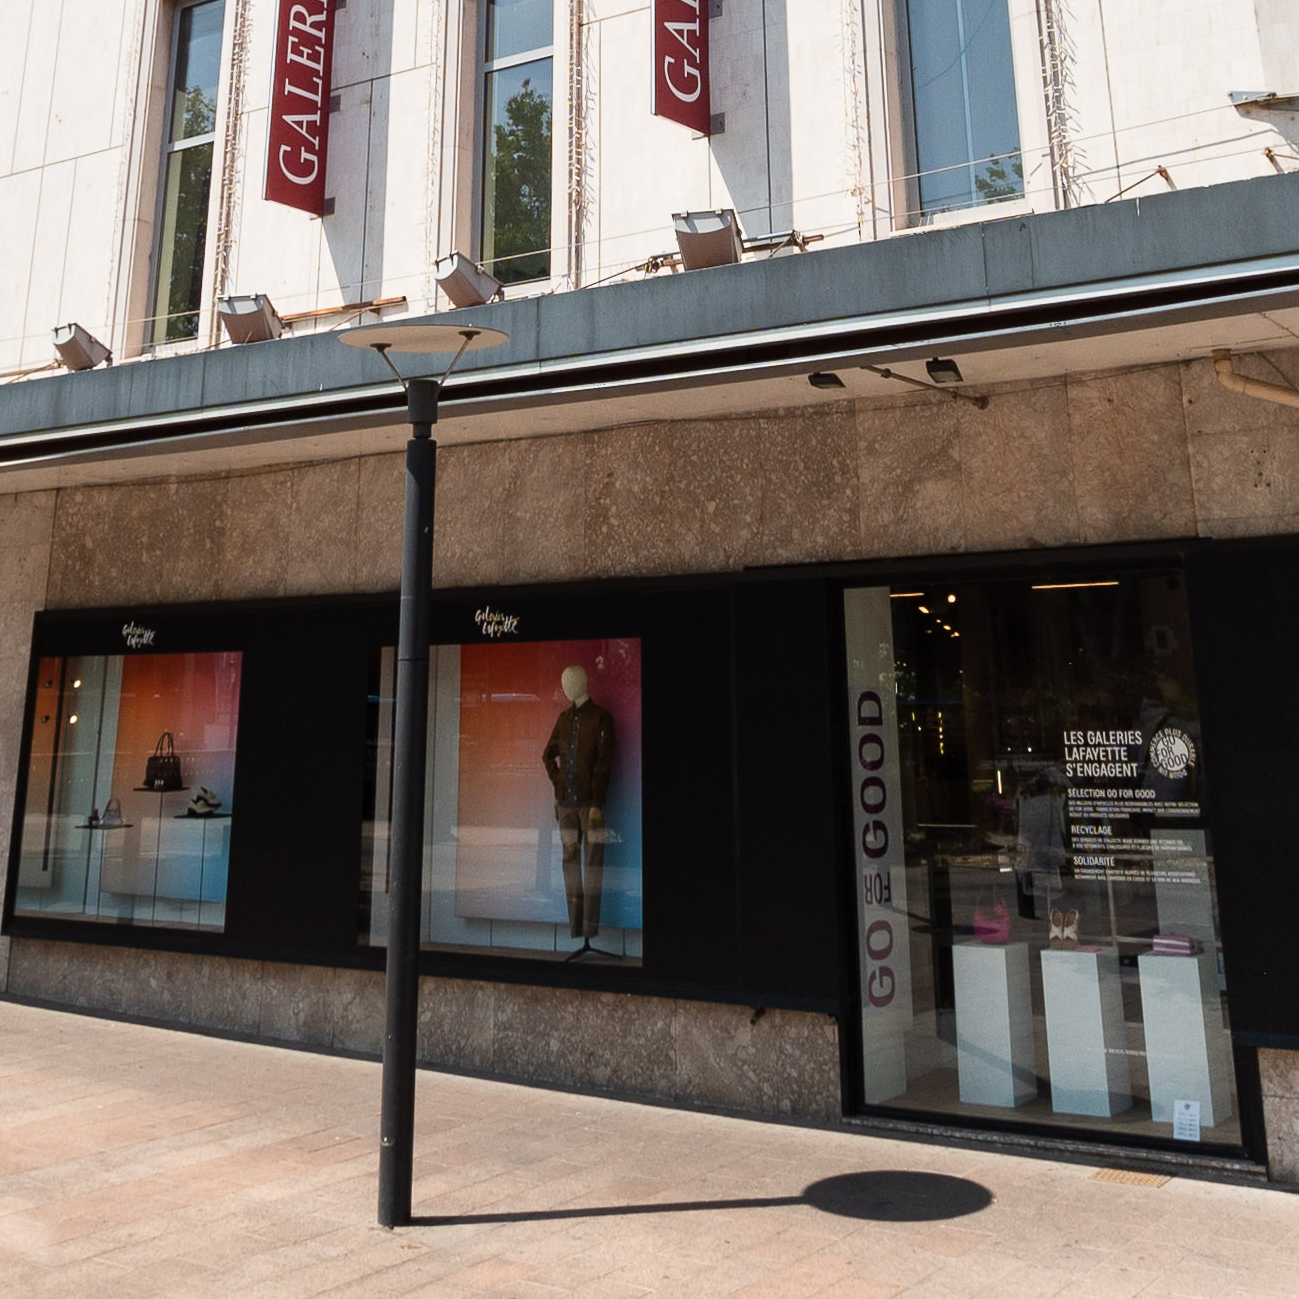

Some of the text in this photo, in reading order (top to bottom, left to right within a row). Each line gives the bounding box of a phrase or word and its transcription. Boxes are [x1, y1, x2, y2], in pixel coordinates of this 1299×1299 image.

[1063, 730, 1143, 745] LES GALERIES
[1064, 746, 1128, 761] LAFAYETTE
[857, 690, 889, 859] GOOD
[1065, 762, 1139, 777] S'ENGAGENT
[1106, 789, 1118, 799] GO
[1119, 789, 1134, 799] FOR
[1134, 789, 1156, 799] GOOD
[1070, 825, 1113, 836] RECYCLAGE
[866, 920, 896, 1008] GO
